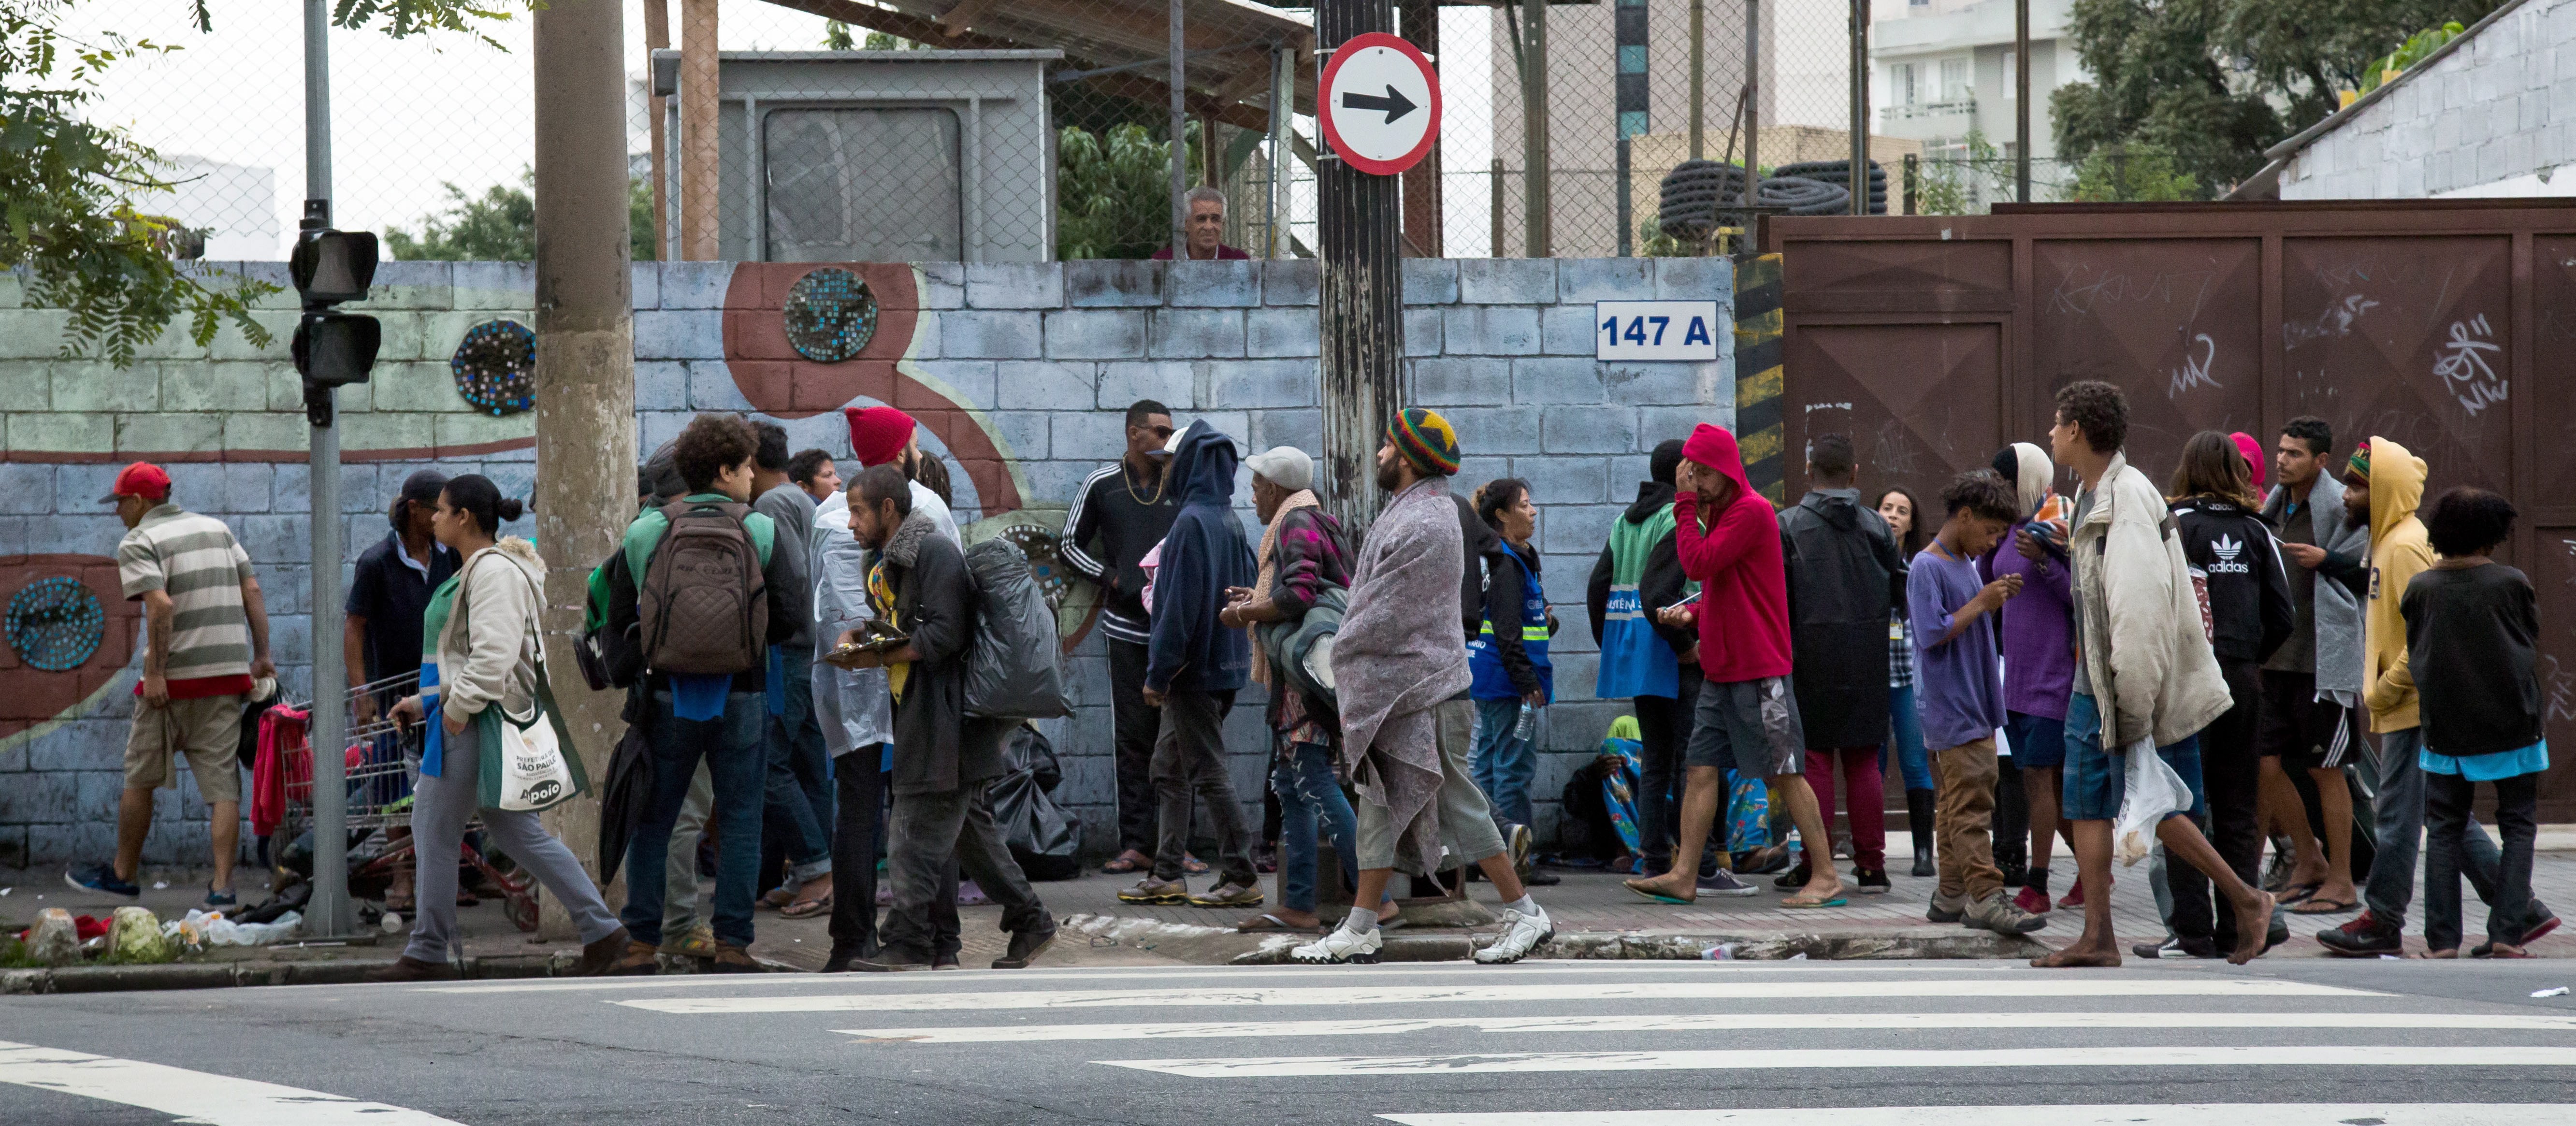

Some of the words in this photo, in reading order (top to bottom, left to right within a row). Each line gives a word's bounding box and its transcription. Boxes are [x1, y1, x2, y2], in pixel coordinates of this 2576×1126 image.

[1602, 316, 1670, 346] 147
[1683, 316, 1711, 346] A
[2208, 560, 2249, 573] adidas
[520, 783, 560, 804] Apoio
